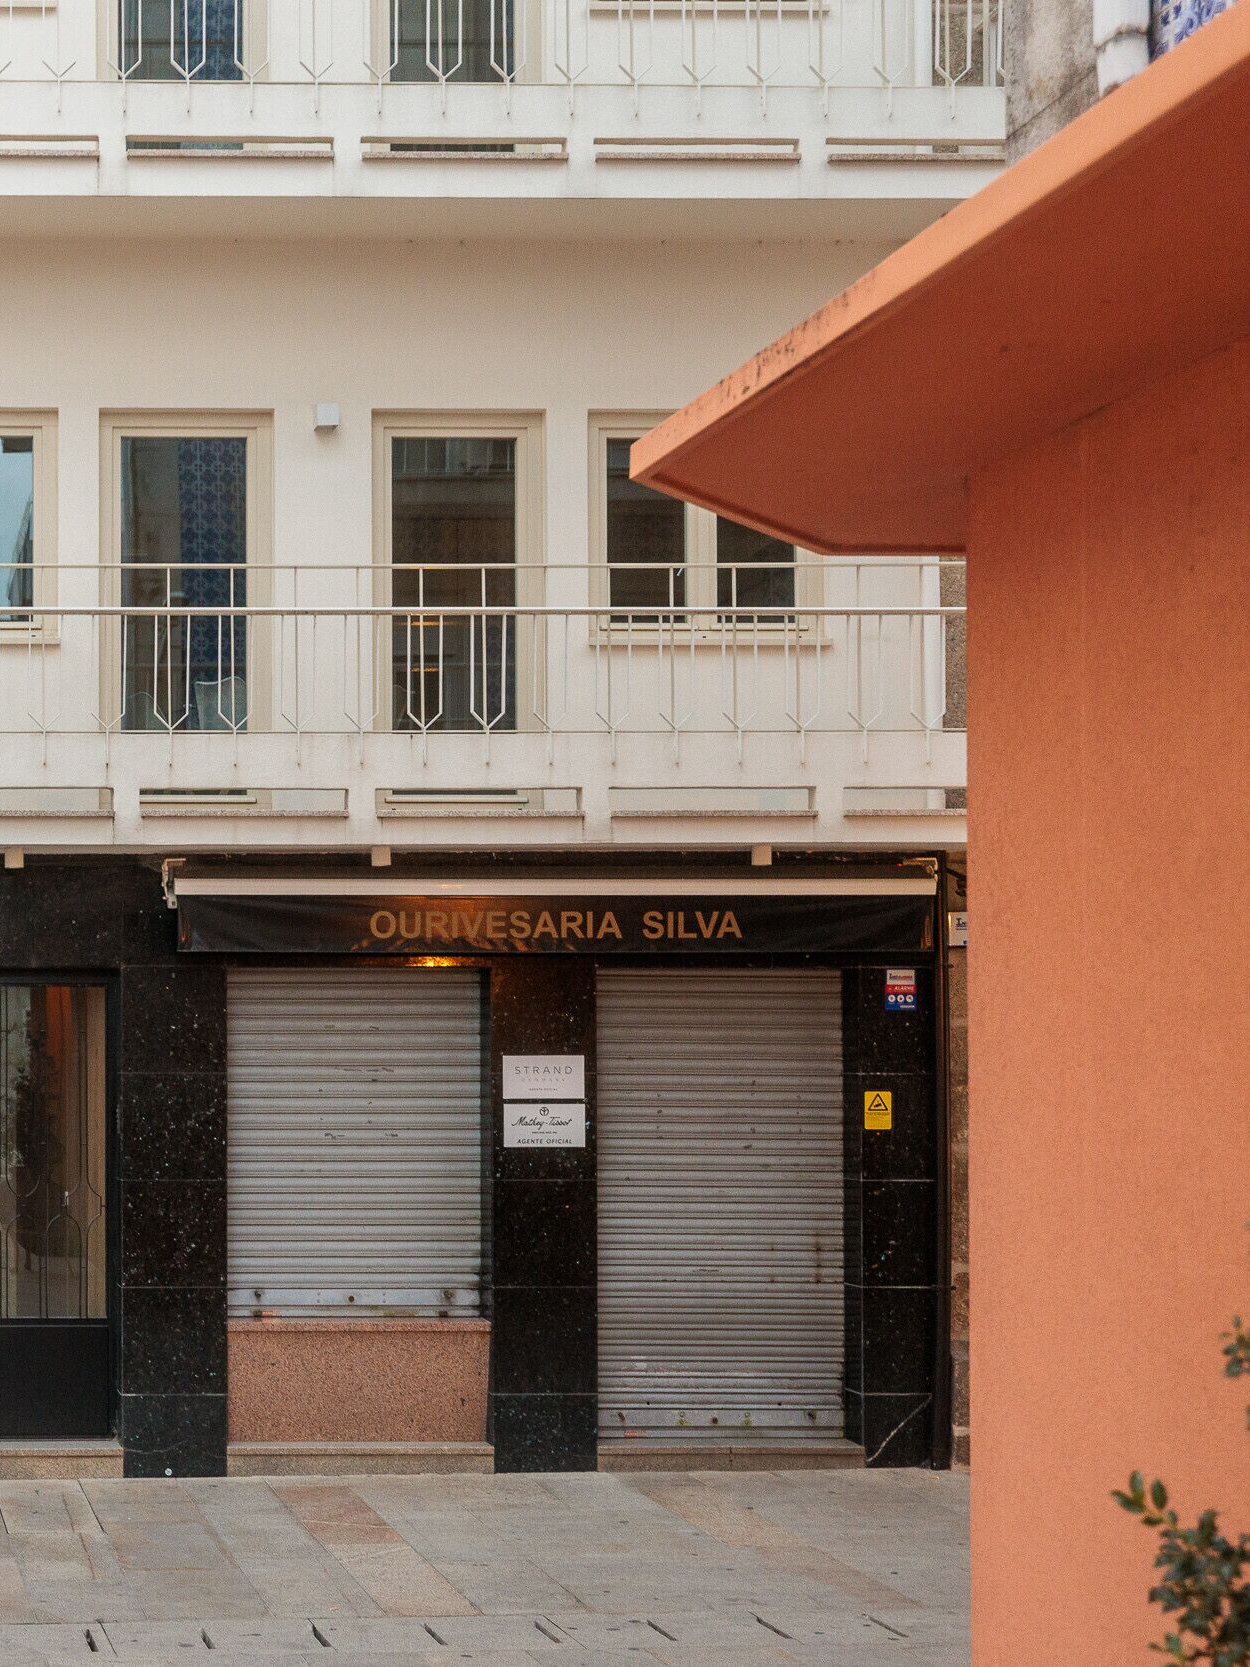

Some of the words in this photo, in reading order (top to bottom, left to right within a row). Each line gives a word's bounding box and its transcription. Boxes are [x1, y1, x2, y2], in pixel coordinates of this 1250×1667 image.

[369, 910, 624, 939] OURIVESARIA
[642, 911, 743, 939] SILVA
[514, 1066, 573, 1075] STRAND
